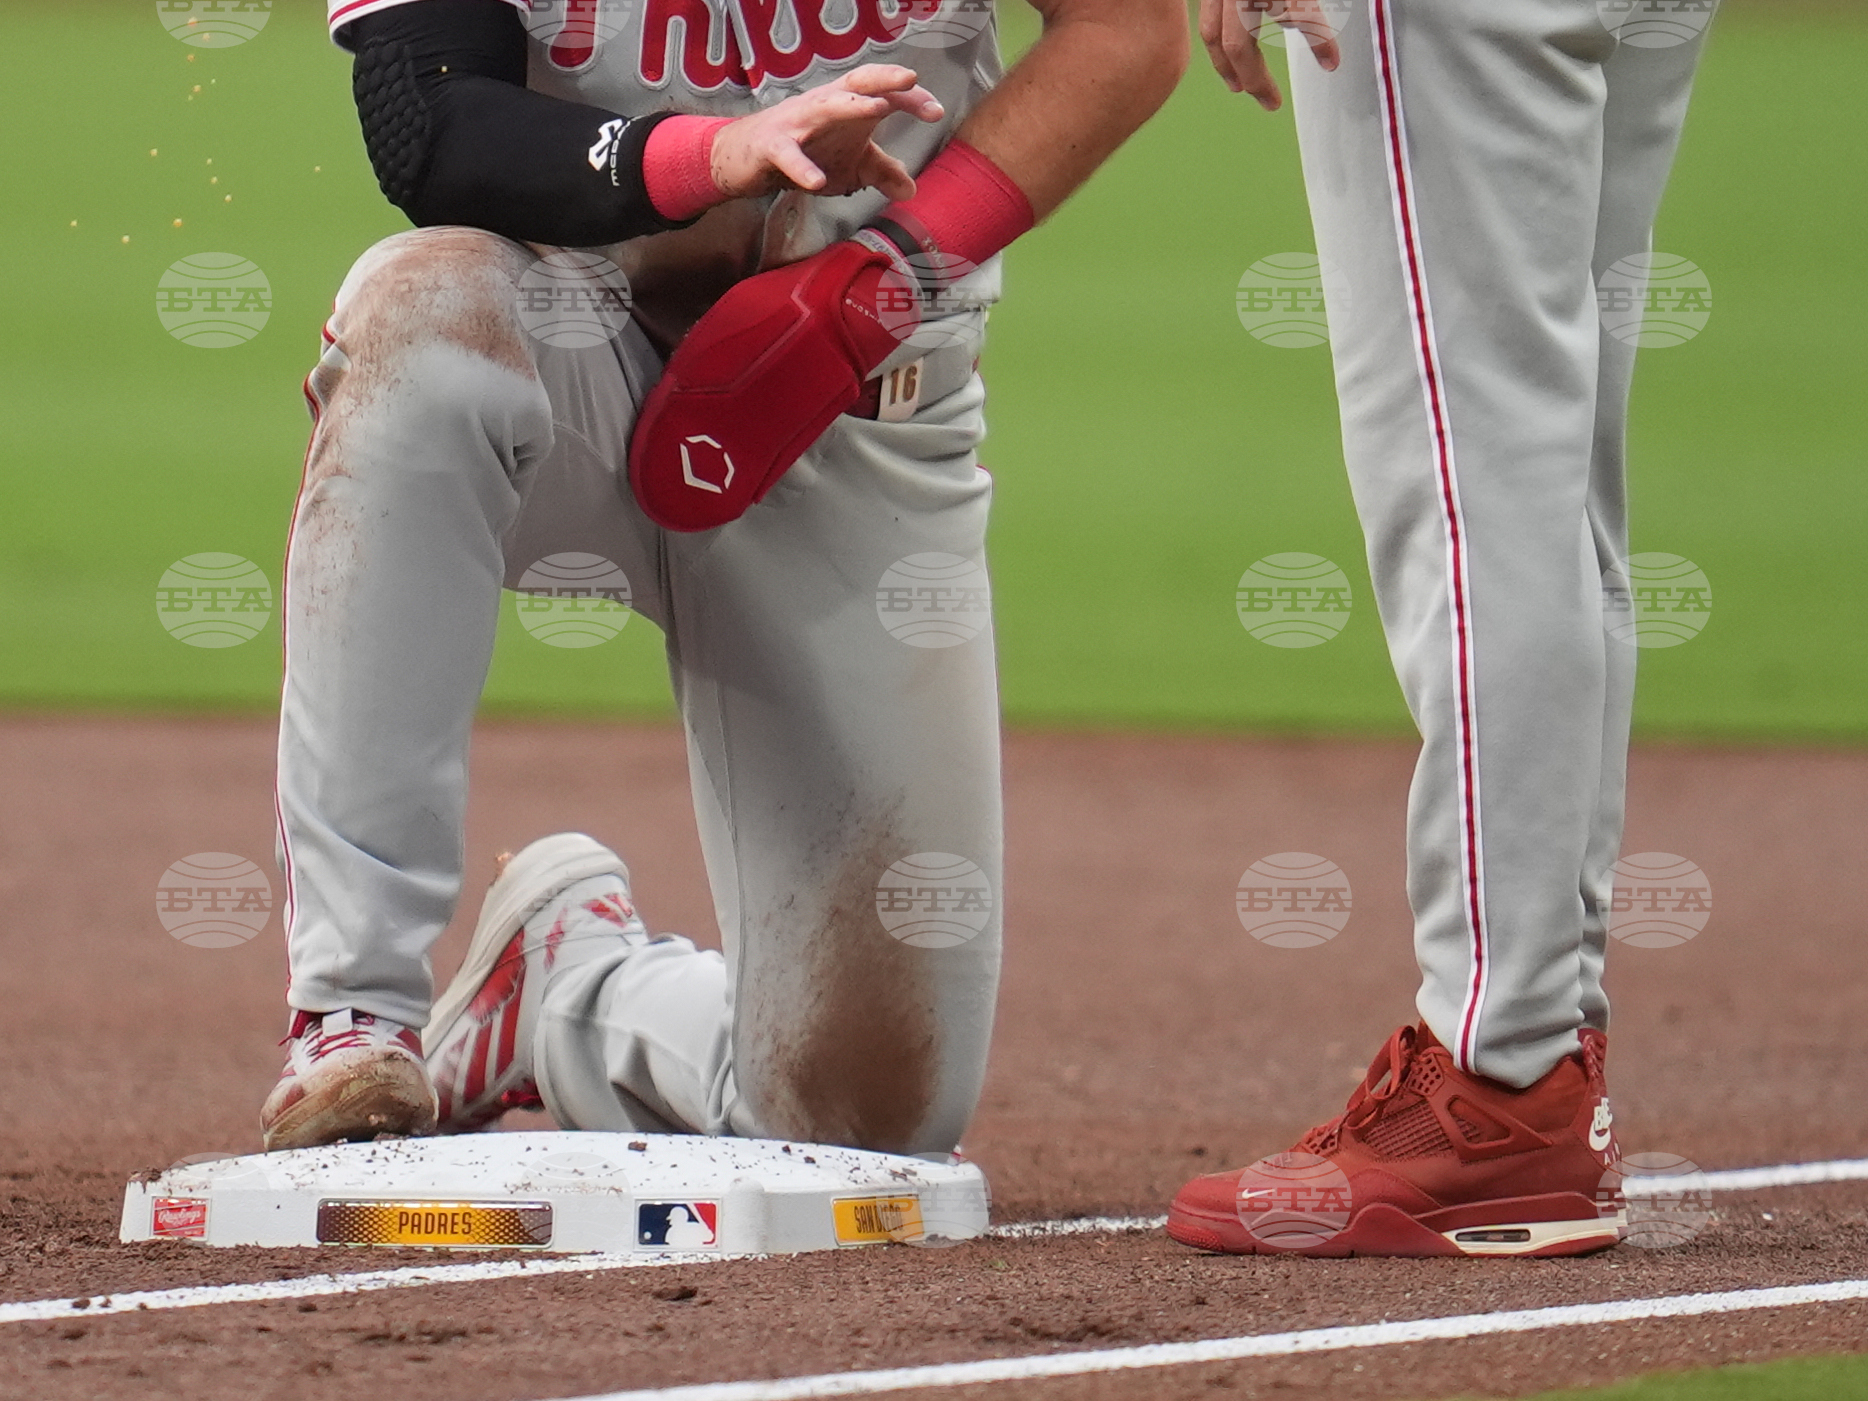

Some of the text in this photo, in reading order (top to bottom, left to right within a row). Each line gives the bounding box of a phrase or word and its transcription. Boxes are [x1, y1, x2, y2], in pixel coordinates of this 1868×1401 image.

[889, 365, 918, 405] 16
[398, 1211, 472, 1235] PADRES
[854, 1205, 875, 1234] SAN
